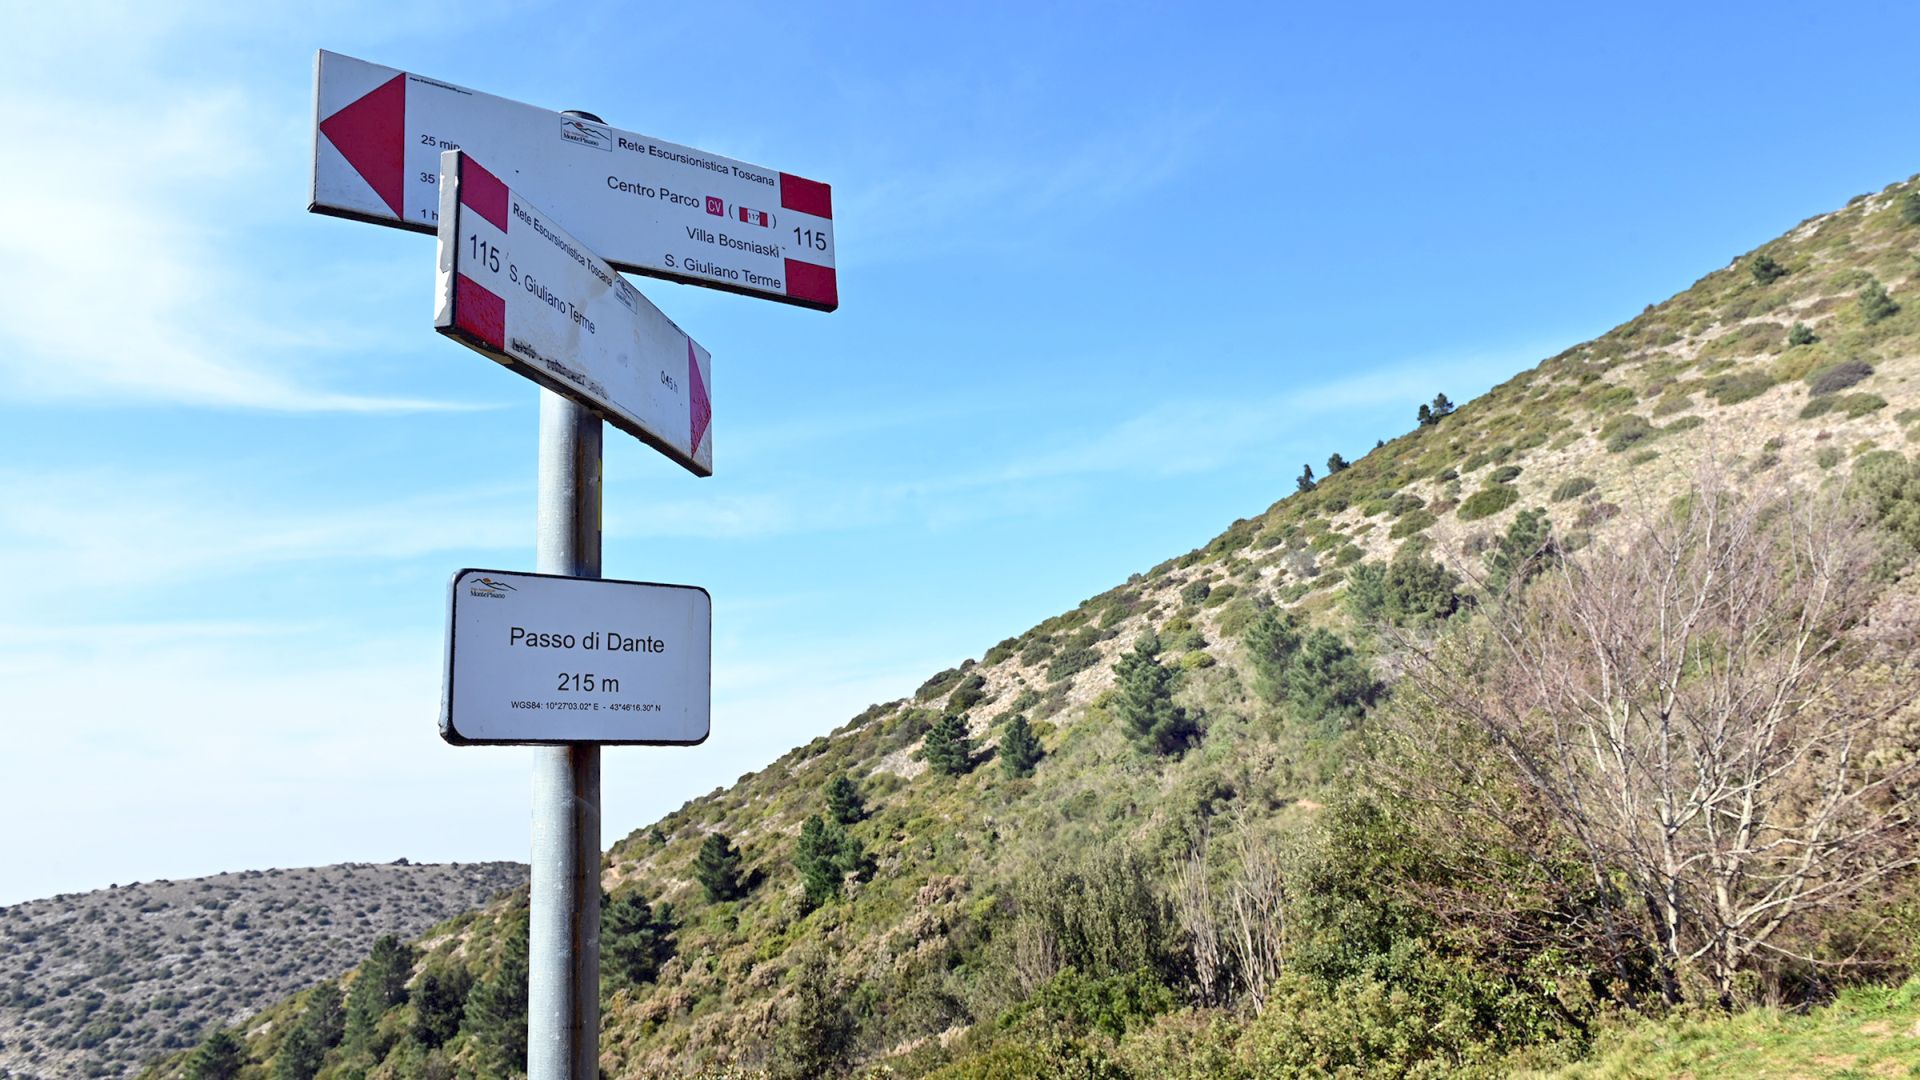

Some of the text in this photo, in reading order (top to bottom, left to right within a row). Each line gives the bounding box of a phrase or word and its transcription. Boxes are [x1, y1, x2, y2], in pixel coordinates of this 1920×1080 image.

[421, 134, 436, 147] 25
[618, 137, 775, 186] Rete Escursionistica Toscana
[420, 172, 435, 184] 35
[607, 176, 655, 198] Centro
[660, 187, 700, 208] Parco
[707, 199, 721, 213] CV
[748, 212, 760, 221] 117
[421, 209, 438, 220] 1 h
[470, 233, 500, 273] 115
[513, 202, 613, 287] Rete Escursionistica Toscana
[686, 226, 779, 258] Villa Bosniaski
[793, 226, 827, 251] 115
[664, 253, 781, 288] S. Giuliano Terme
[509, 264, 596, 334] S. Giuliano Terme
[510, 626, 665, 653] Passo di Dante
[557, 672, 619, 693] 215 m
[511, 701, 543, 710] WGS84:
[593, 703, 599, 711] E
[655, 704, 661, 712] N
